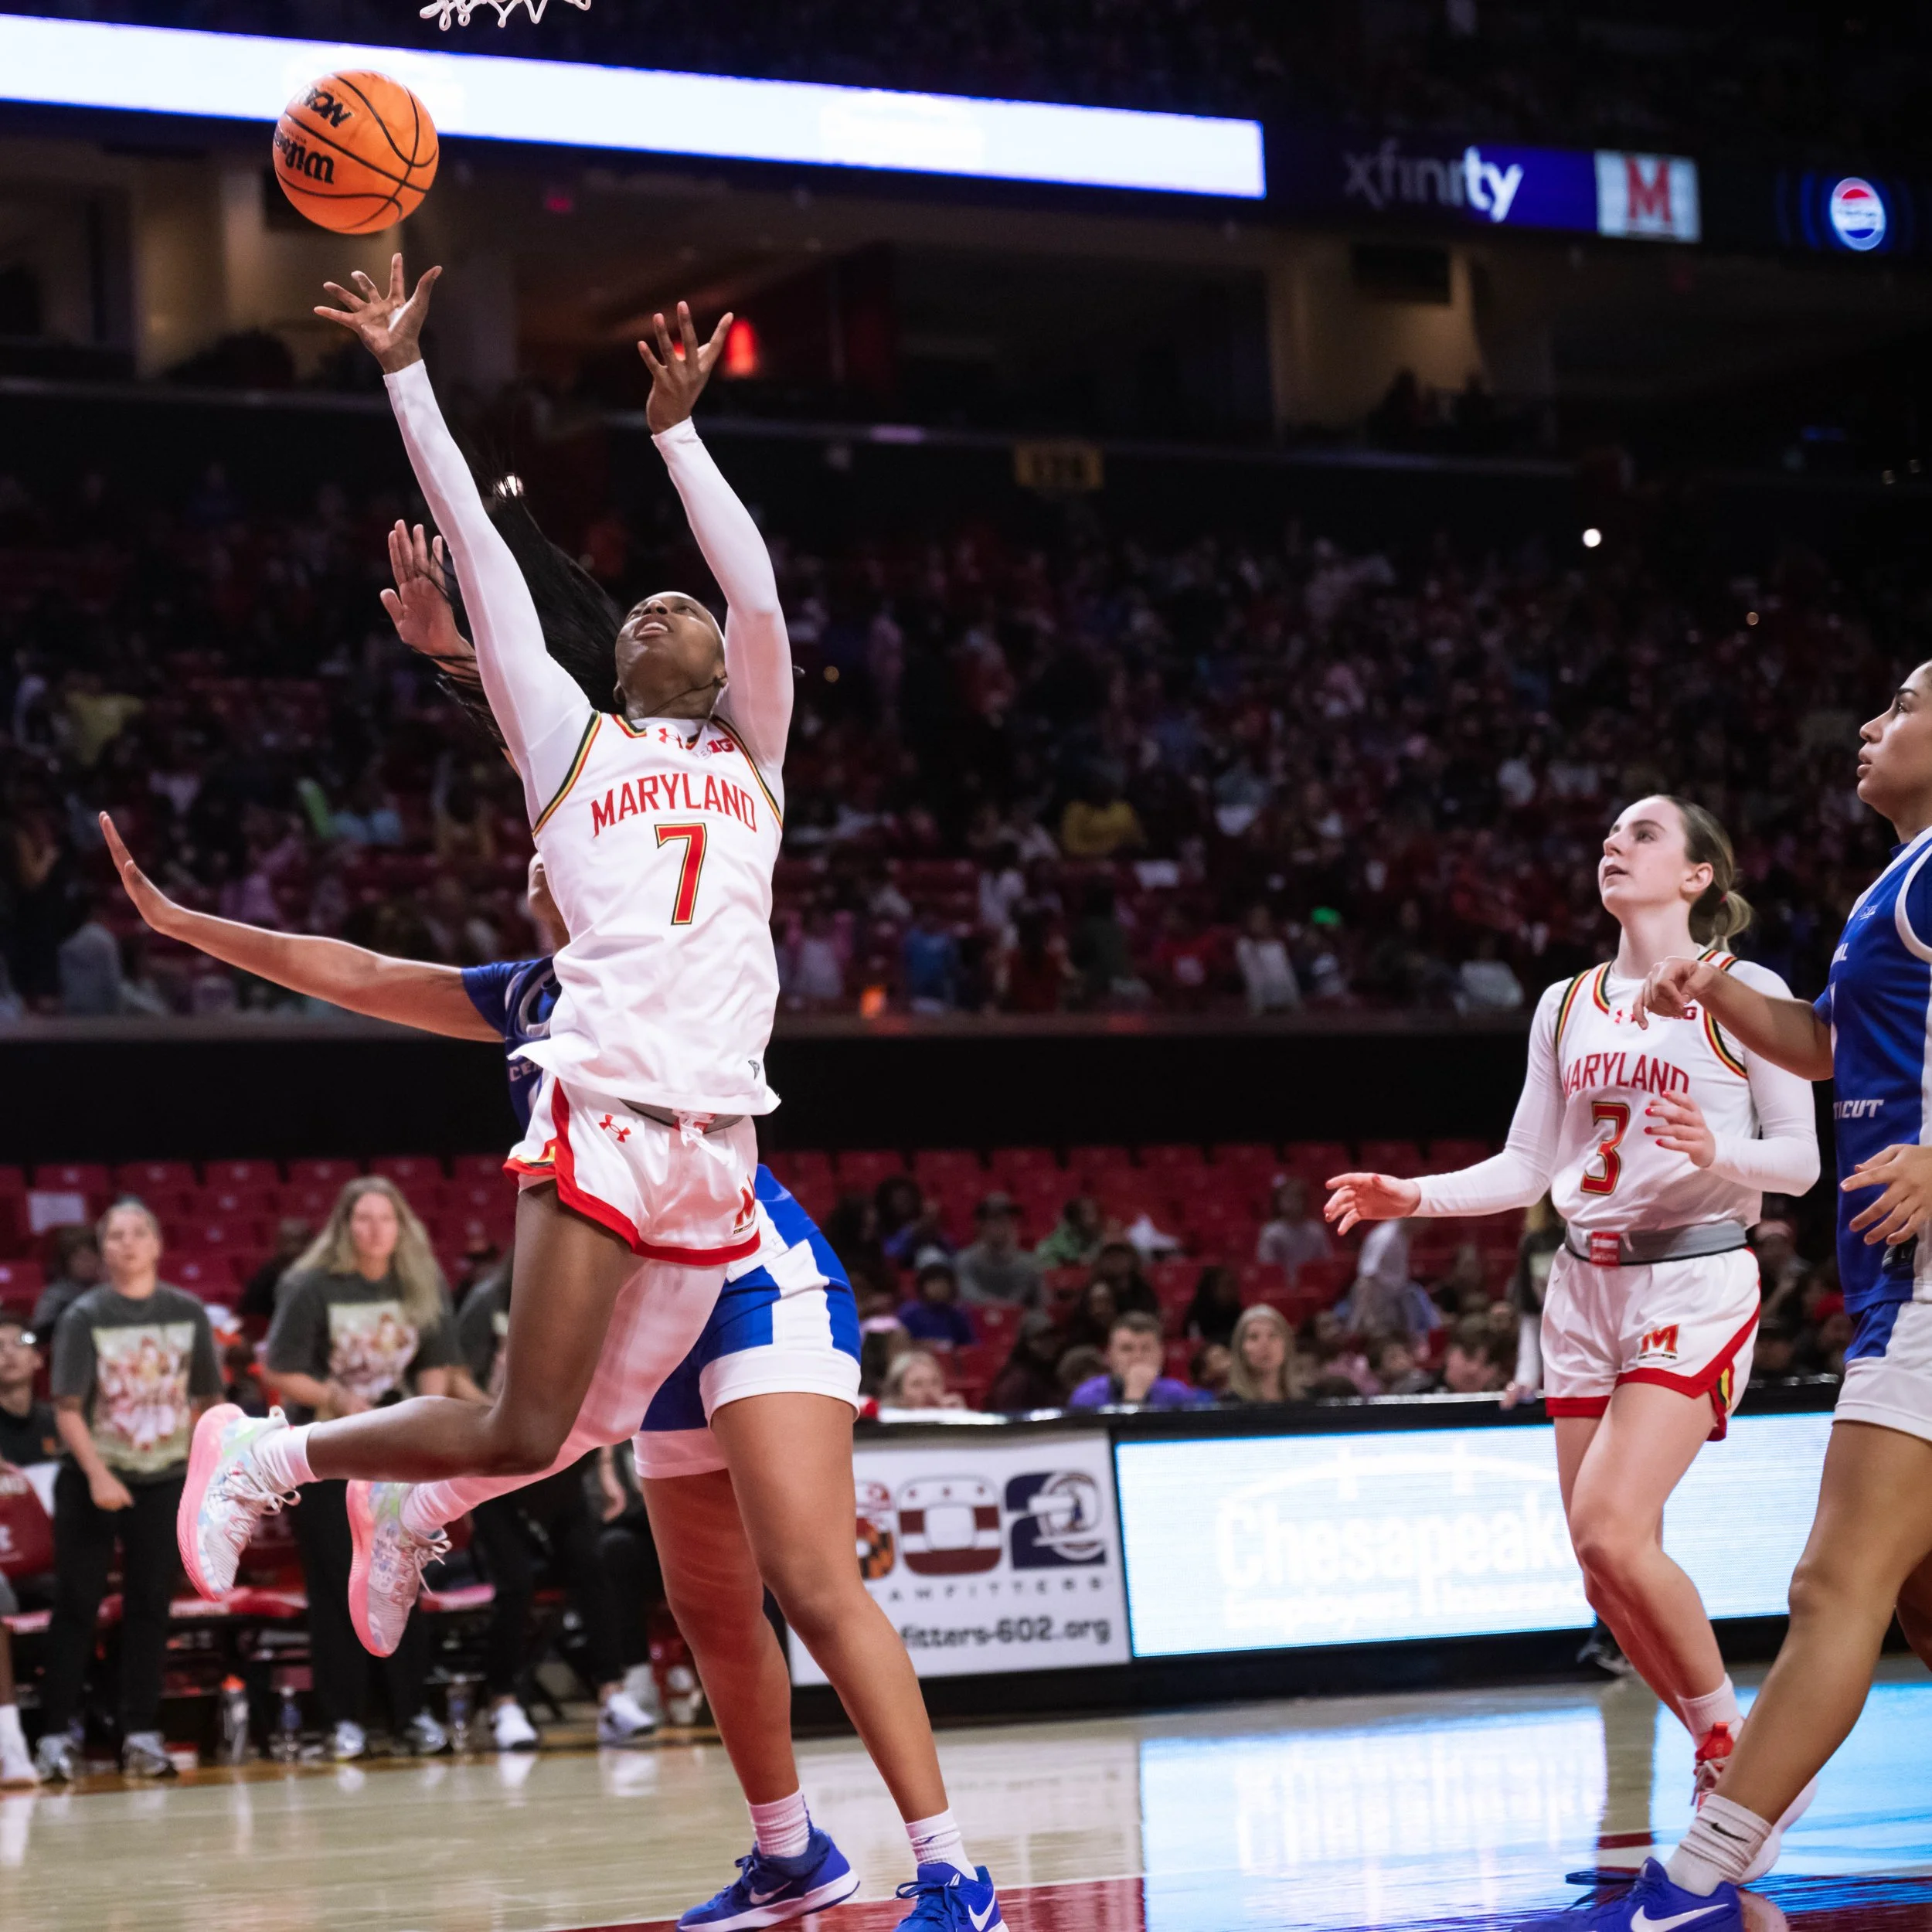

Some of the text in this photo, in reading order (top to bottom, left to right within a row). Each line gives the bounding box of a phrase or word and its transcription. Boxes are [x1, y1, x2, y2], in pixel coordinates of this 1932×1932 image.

[590, 772, 757, 838] MARYLAND
[654, 822, 708, 925] 7
[1580, 1100, 1631, 1196] 3
[1639, 1323, 1679, 1355] M
[1216, 1488, 1580, 1617] Chesapeak
